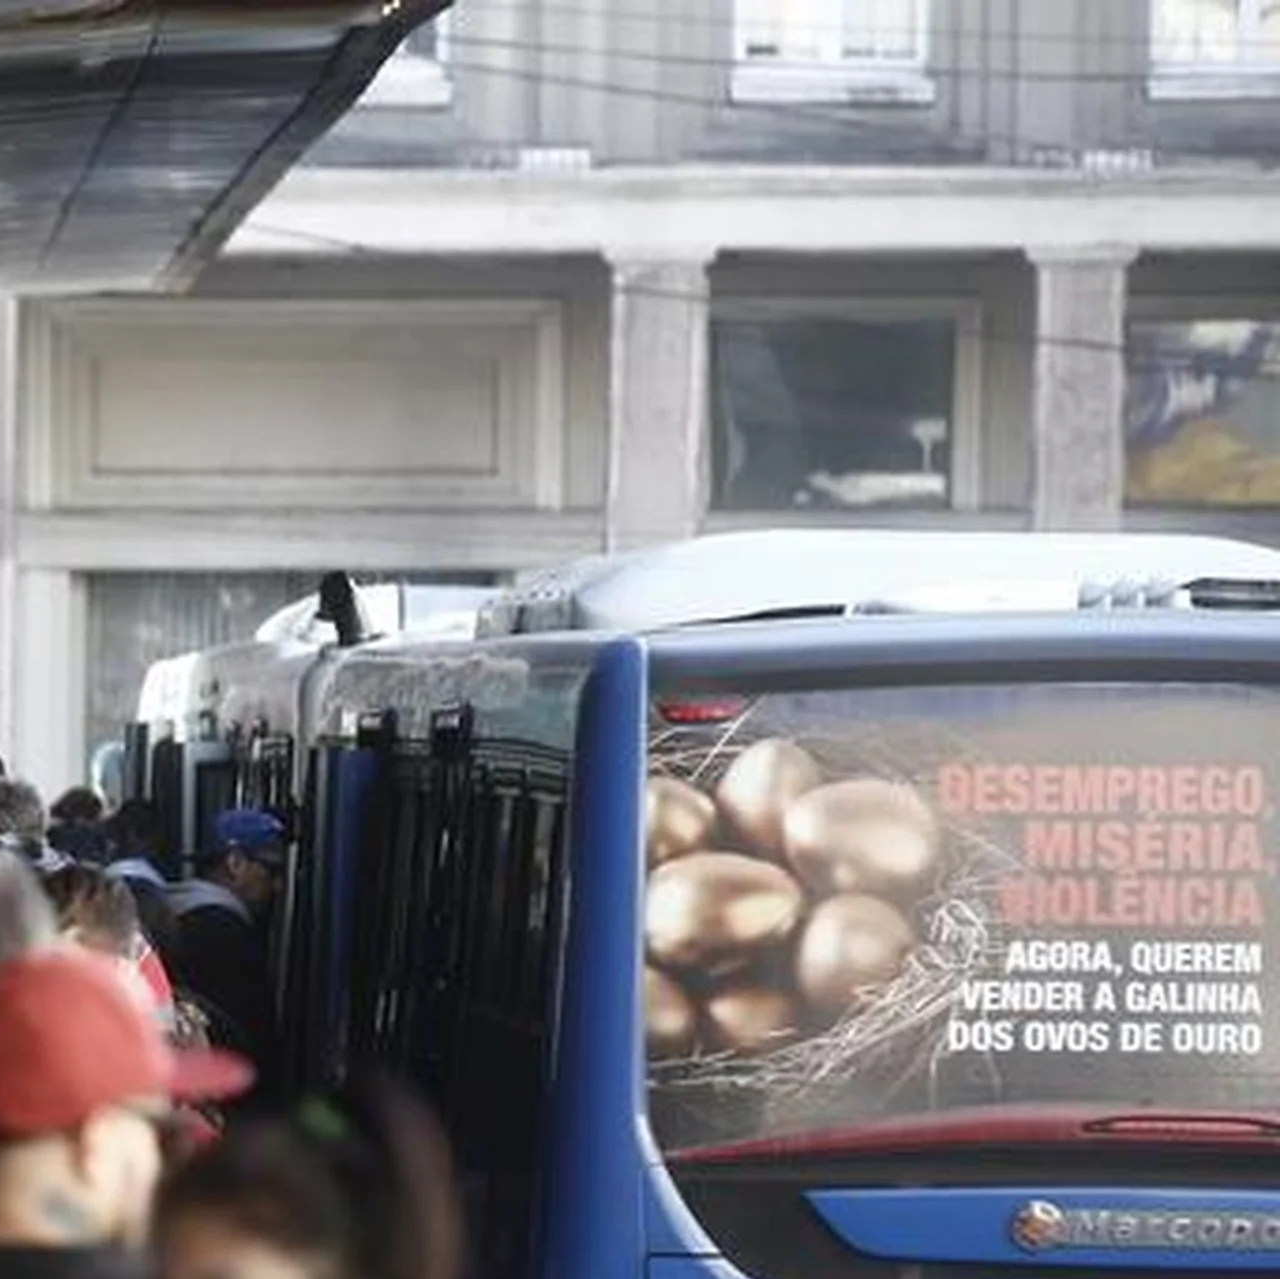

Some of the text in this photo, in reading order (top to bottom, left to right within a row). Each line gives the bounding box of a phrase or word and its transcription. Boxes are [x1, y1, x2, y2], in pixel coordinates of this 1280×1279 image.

[996, 867, 1264, 926] VIOLÊNCIA
[1006, 942, 1262, 977] AGORA, QUEREM
[962, 981, 1262, 1014] VENDER A GALINHA
[949, 1020, 1262, 1053] DOS OVOS DE OURO
